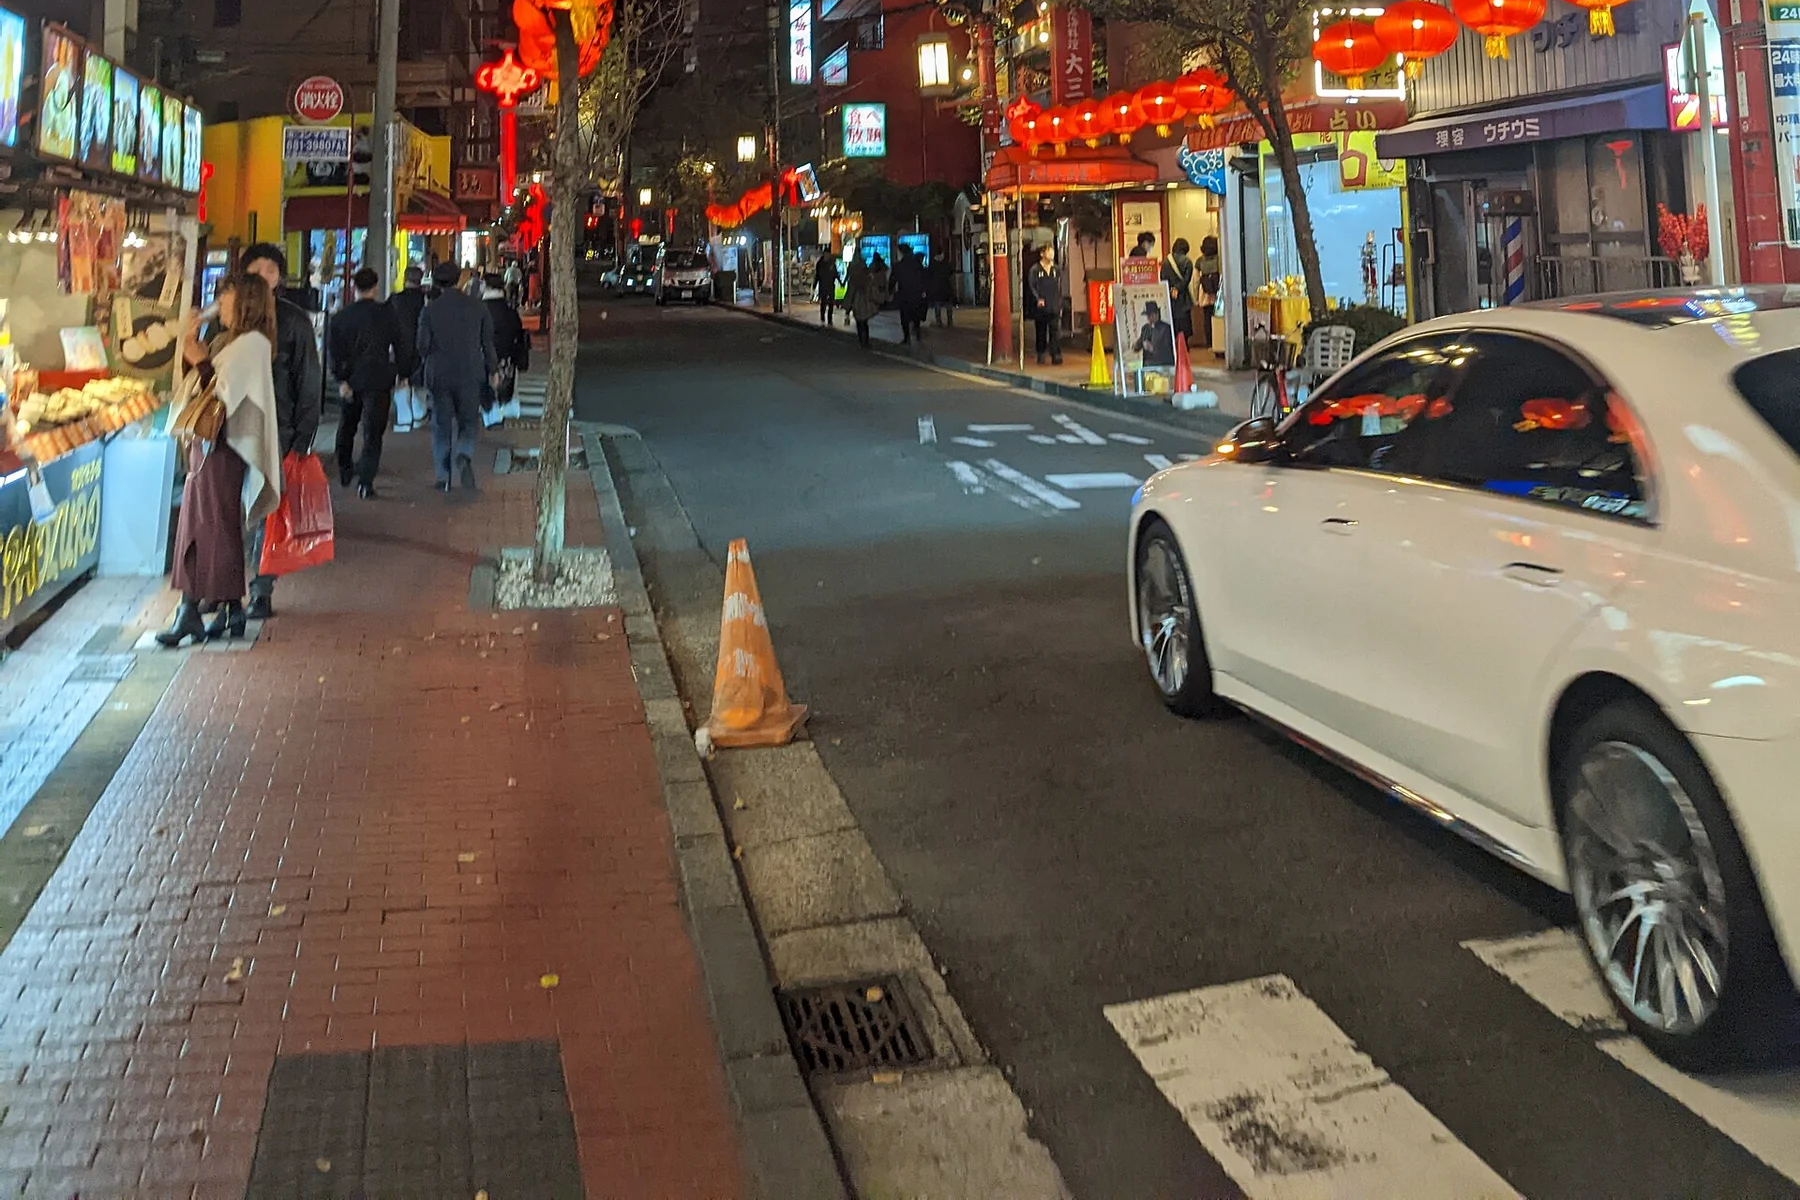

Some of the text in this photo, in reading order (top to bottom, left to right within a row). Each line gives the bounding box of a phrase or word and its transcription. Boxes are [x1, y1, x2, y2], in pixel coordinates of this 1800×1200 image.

[300, 91, 338, 109] 消火栓
[1330, 108, 1377, 130] 占い
[1435, 117, 1540, 148] 理容 ウチウミ
